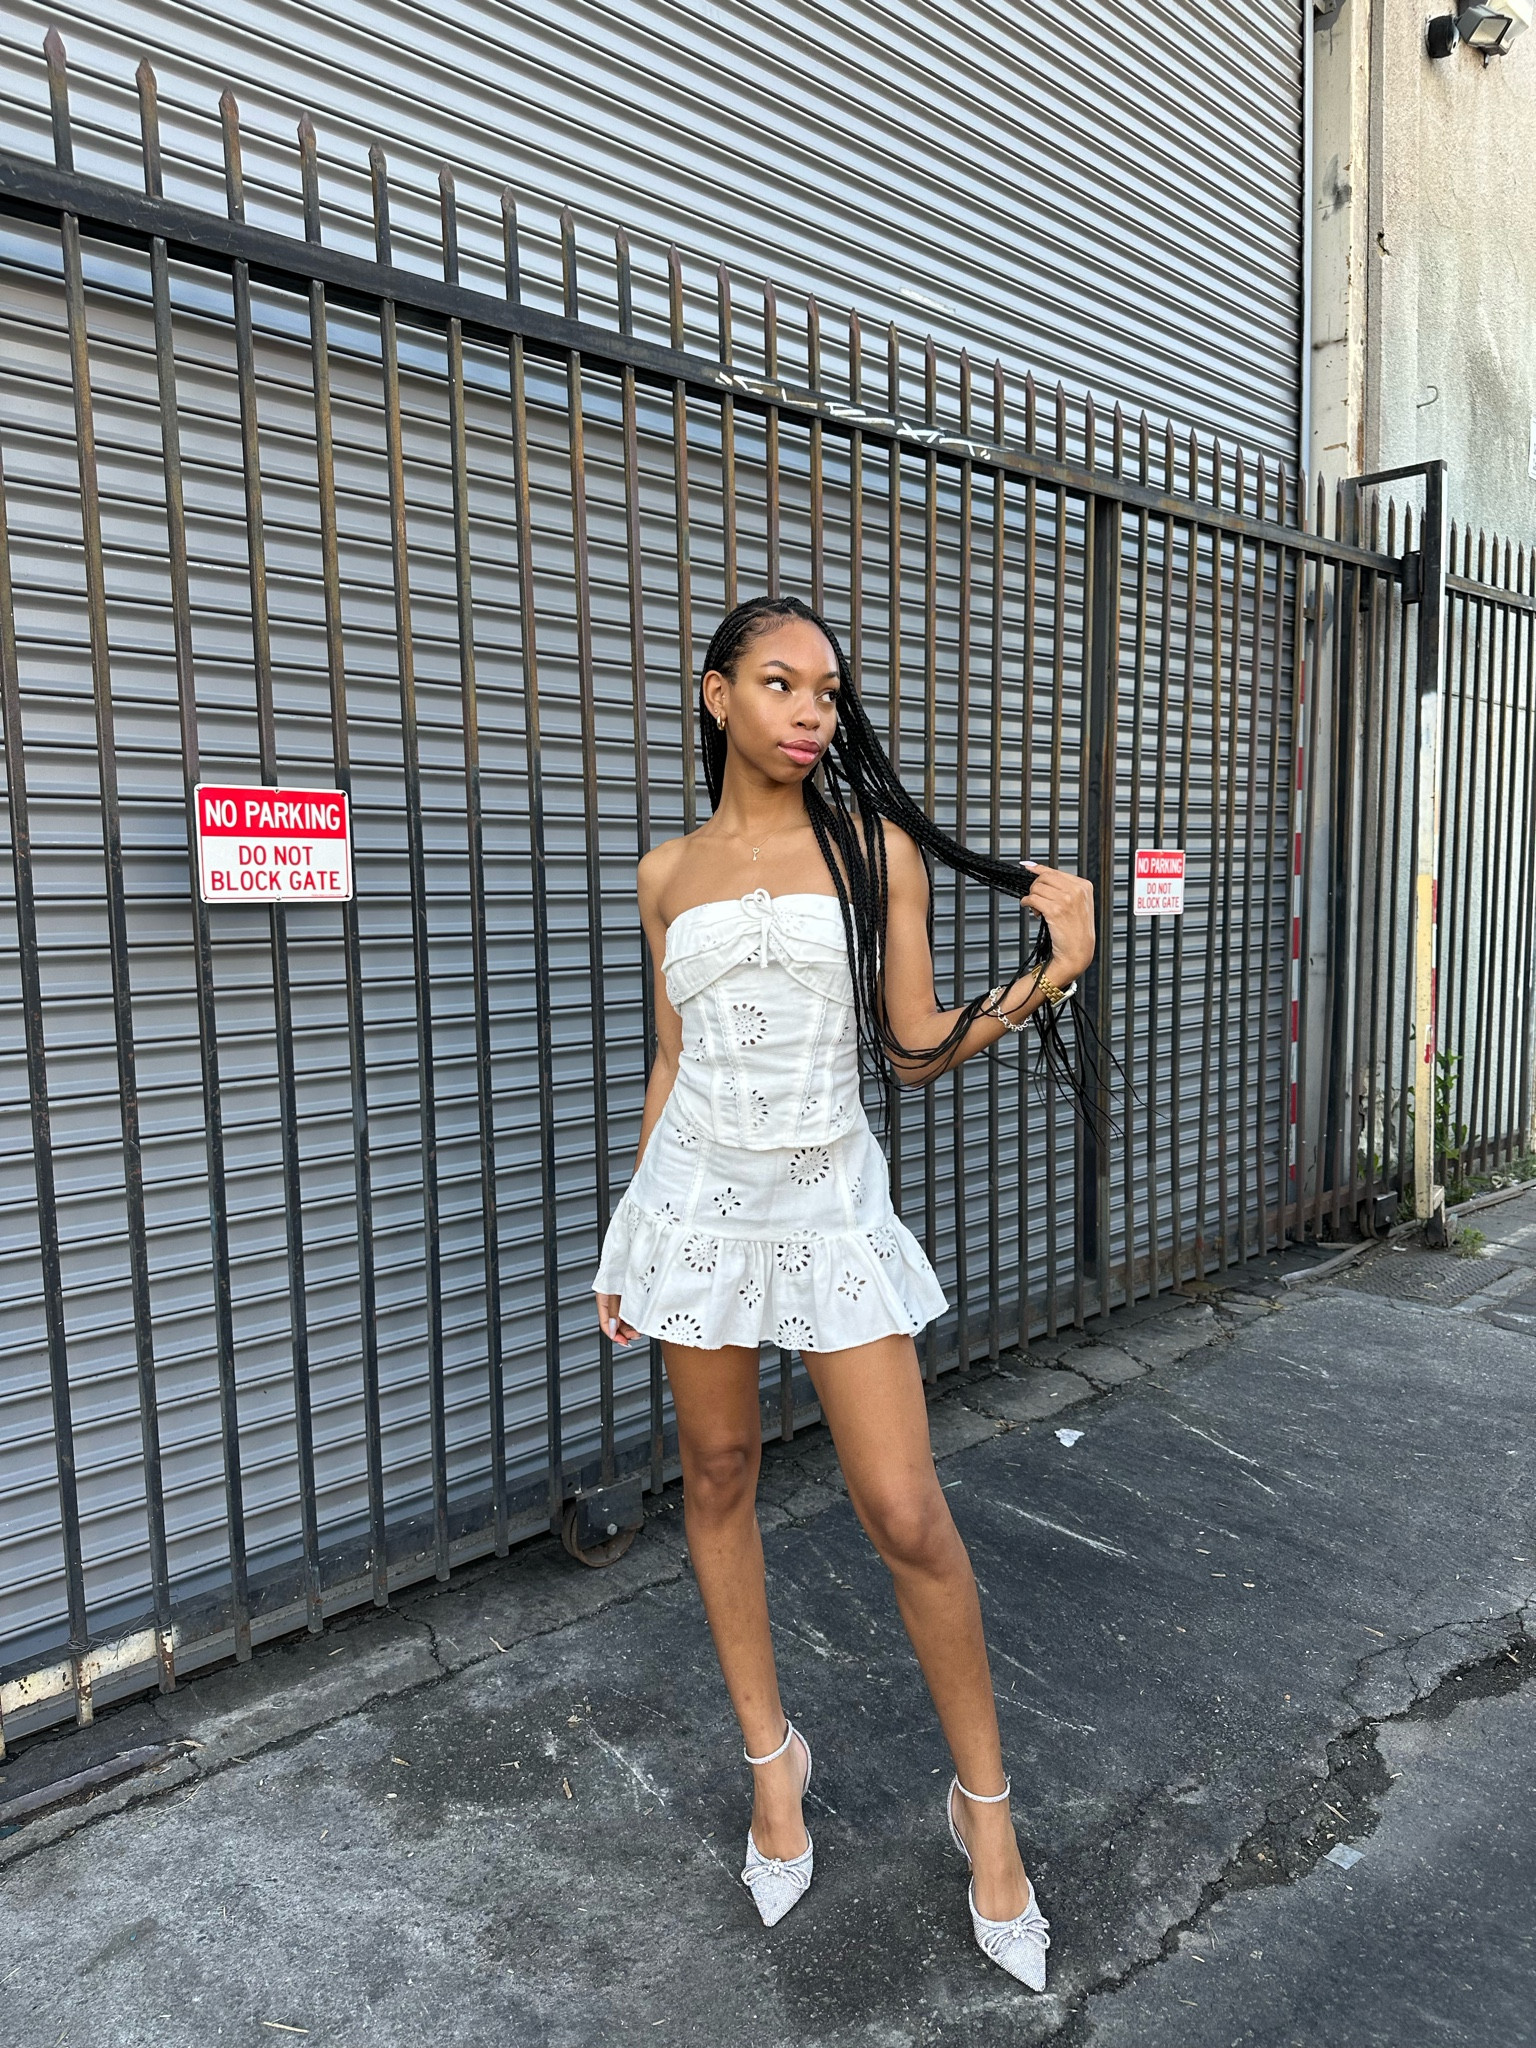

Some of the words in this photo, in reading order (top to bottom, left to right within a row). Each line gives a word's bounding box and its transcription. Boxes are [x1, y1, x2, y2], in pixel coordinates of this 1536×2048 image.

[204, 799, 237, 828] NO
[245, 801, 341, 831] PARKING
[238, 845, 267, 866] DO
[274, 845, 313, 866] NOT
[1137, 857, 1149, 874] NO
[1150, 857, 1182, 874] PARKING
[210, 871, 282, 891] BLOCK
[289, 871, 341, 890] GATE
[1147, 882, 1157, 895] DO
[1158, 882, 1172, 895] NOT
[1137, 897, 1160, 909] BLOCK
[1162, 896, 1180, 908] GATE
